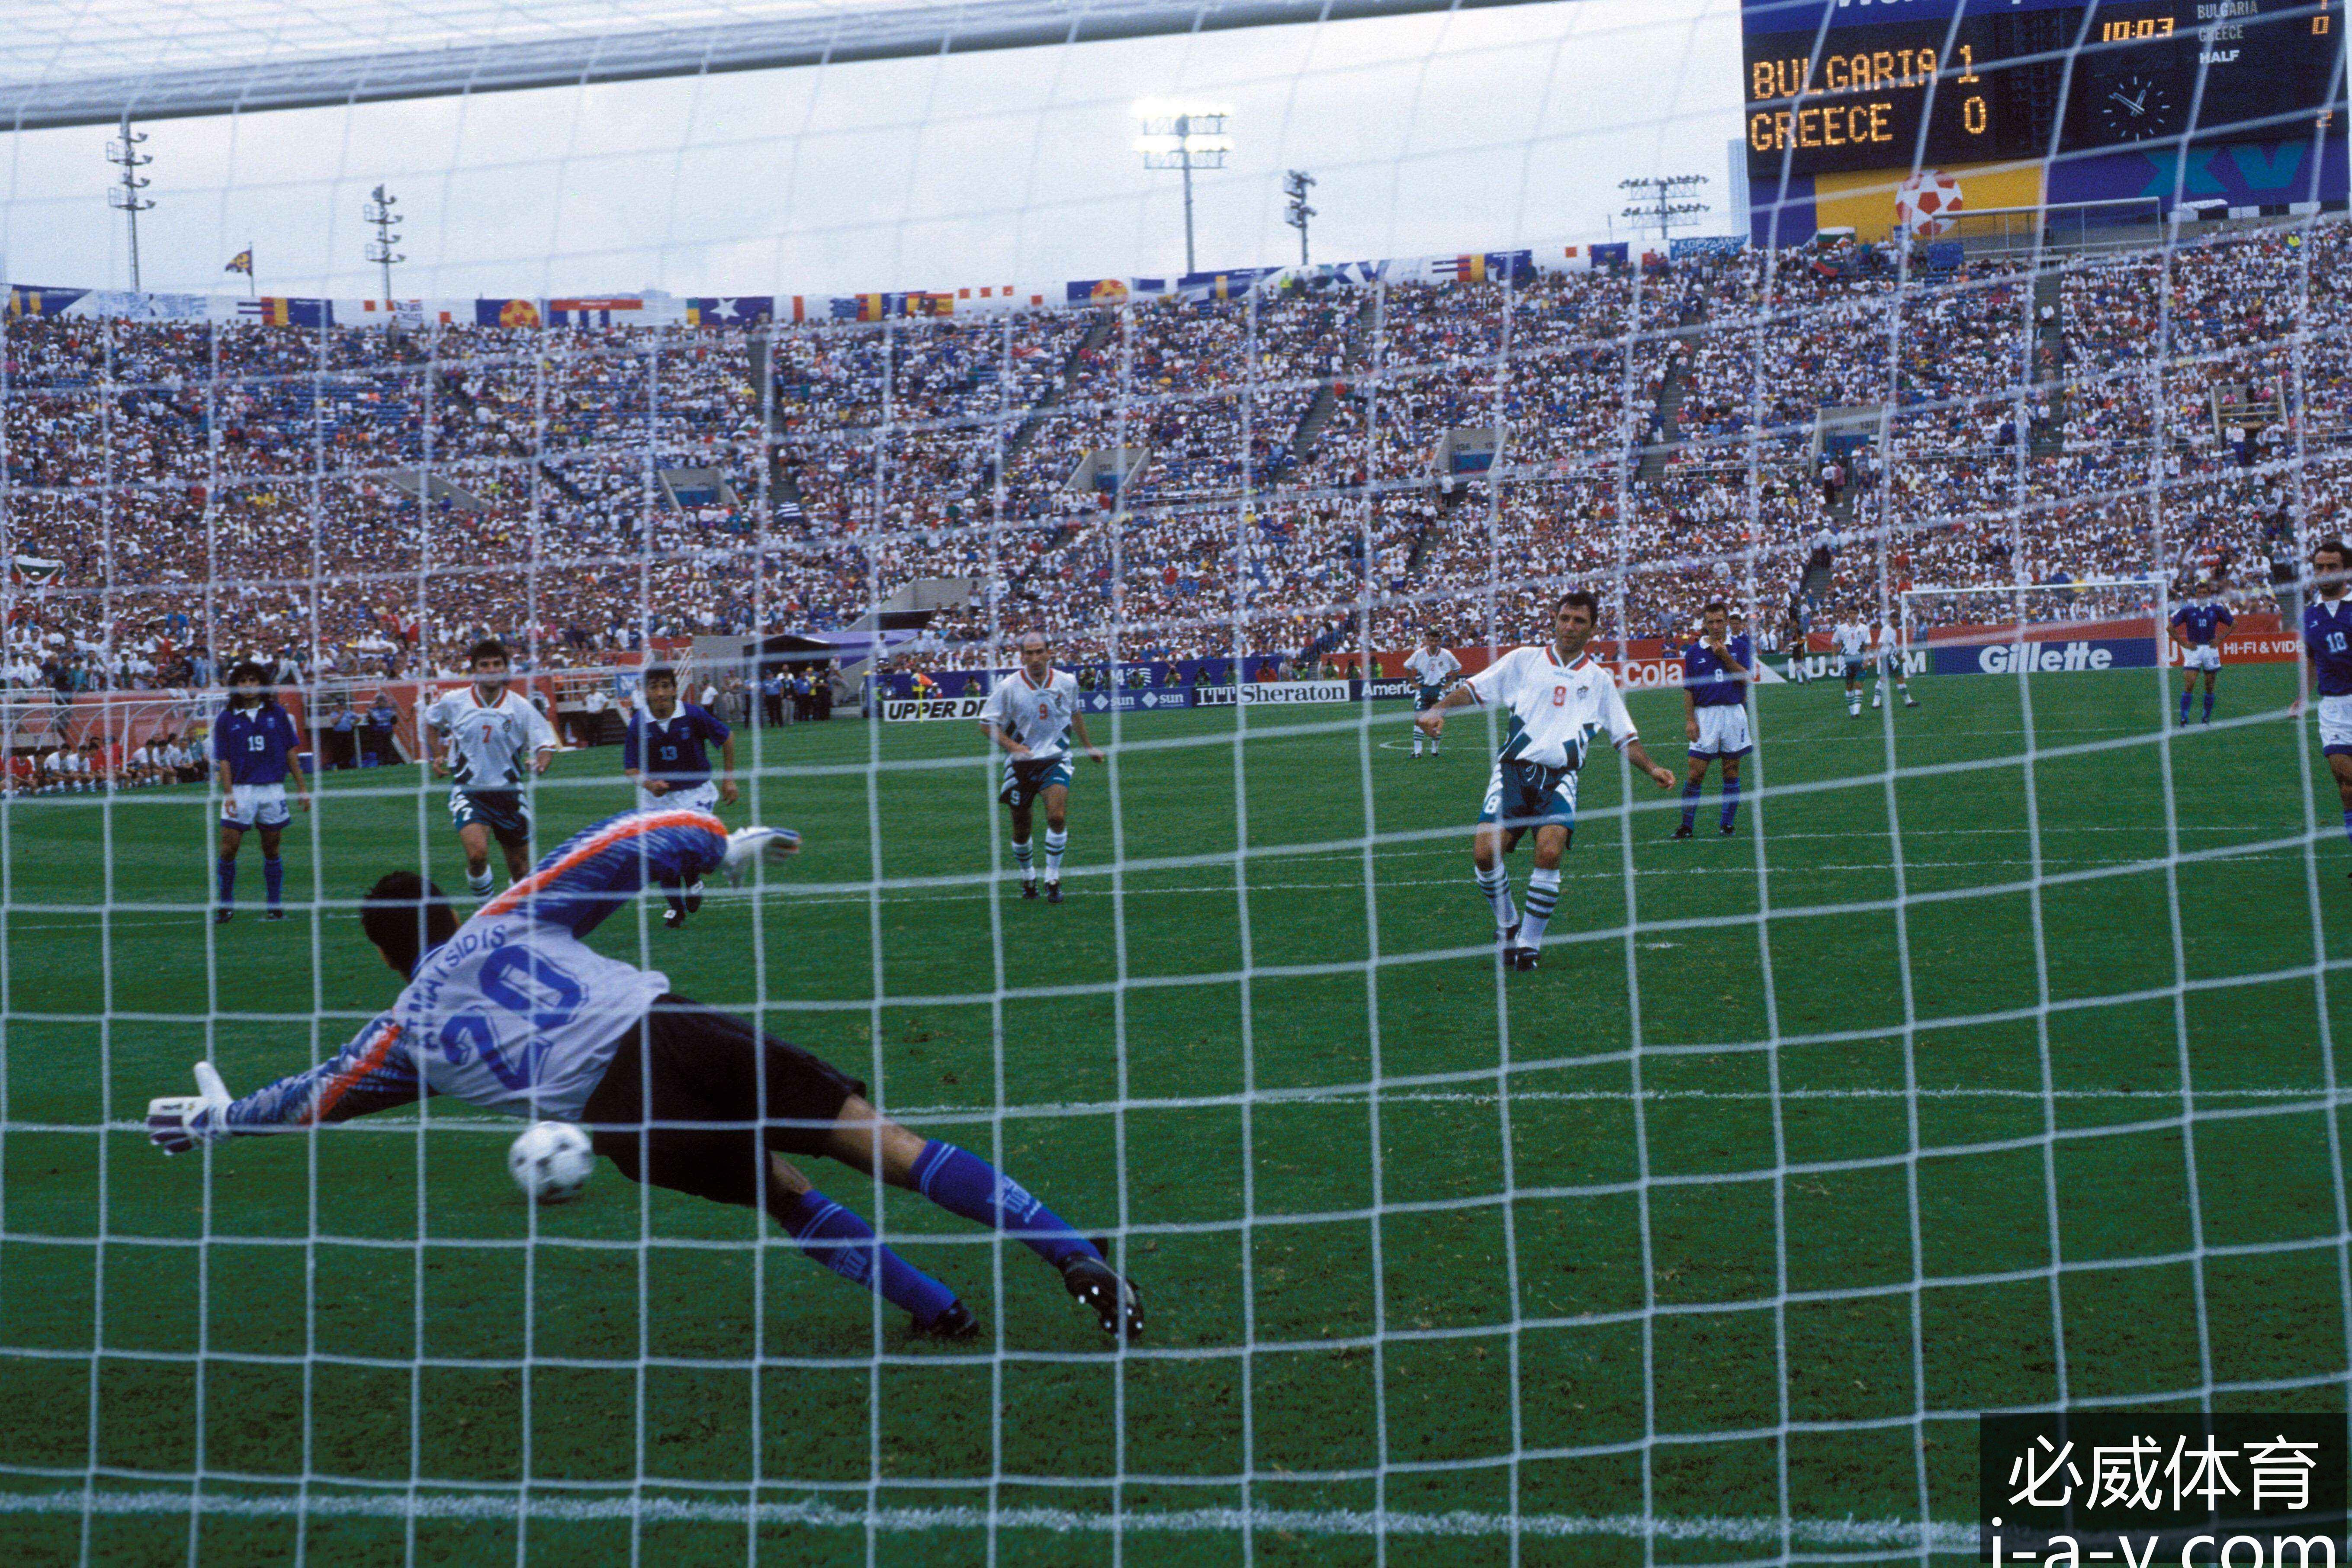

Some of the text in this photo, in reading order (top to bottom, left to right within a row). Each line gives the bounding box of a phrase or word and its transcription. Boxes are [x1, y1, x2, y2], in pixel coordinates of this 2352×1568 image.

[2103, 18, 2174, 42] 10:03
[2198, 16, 2330, 42] GREECE 0
[2199, 50, 2240, 64] HALF
[1753, 45, 1979, 99] BULGARIA 1
[1751, 96, 1986, 151] GREECE 0
[2223, 639, 2305, 655] HI-FI & VIDE
[1979, 641, 2113, 673] Gillette
[1714, 668, 1724, 682] 8
[1196, 684, 1347, 706] ITT Sheraton
[1361, 681, 1415, 697] Americ
[1552, 685, 1567, 707] 8
[1110, 695, 1134, 707] sun
[1159, 694, 1184, 704] sun
[888, 700, 957, 720] UPPER
[1039, 704, 1049, 720] 9
[482, 725, 492, 744] 7
[247, 736, 265, 752] 19
[660, 745, 678, 761] 13
[1009, 789, 1021, 806] 9
[1484, 794, 1499, 814] 8
[461, 807, 473, 821] 7
[439, 944, 588, 1091] 20
